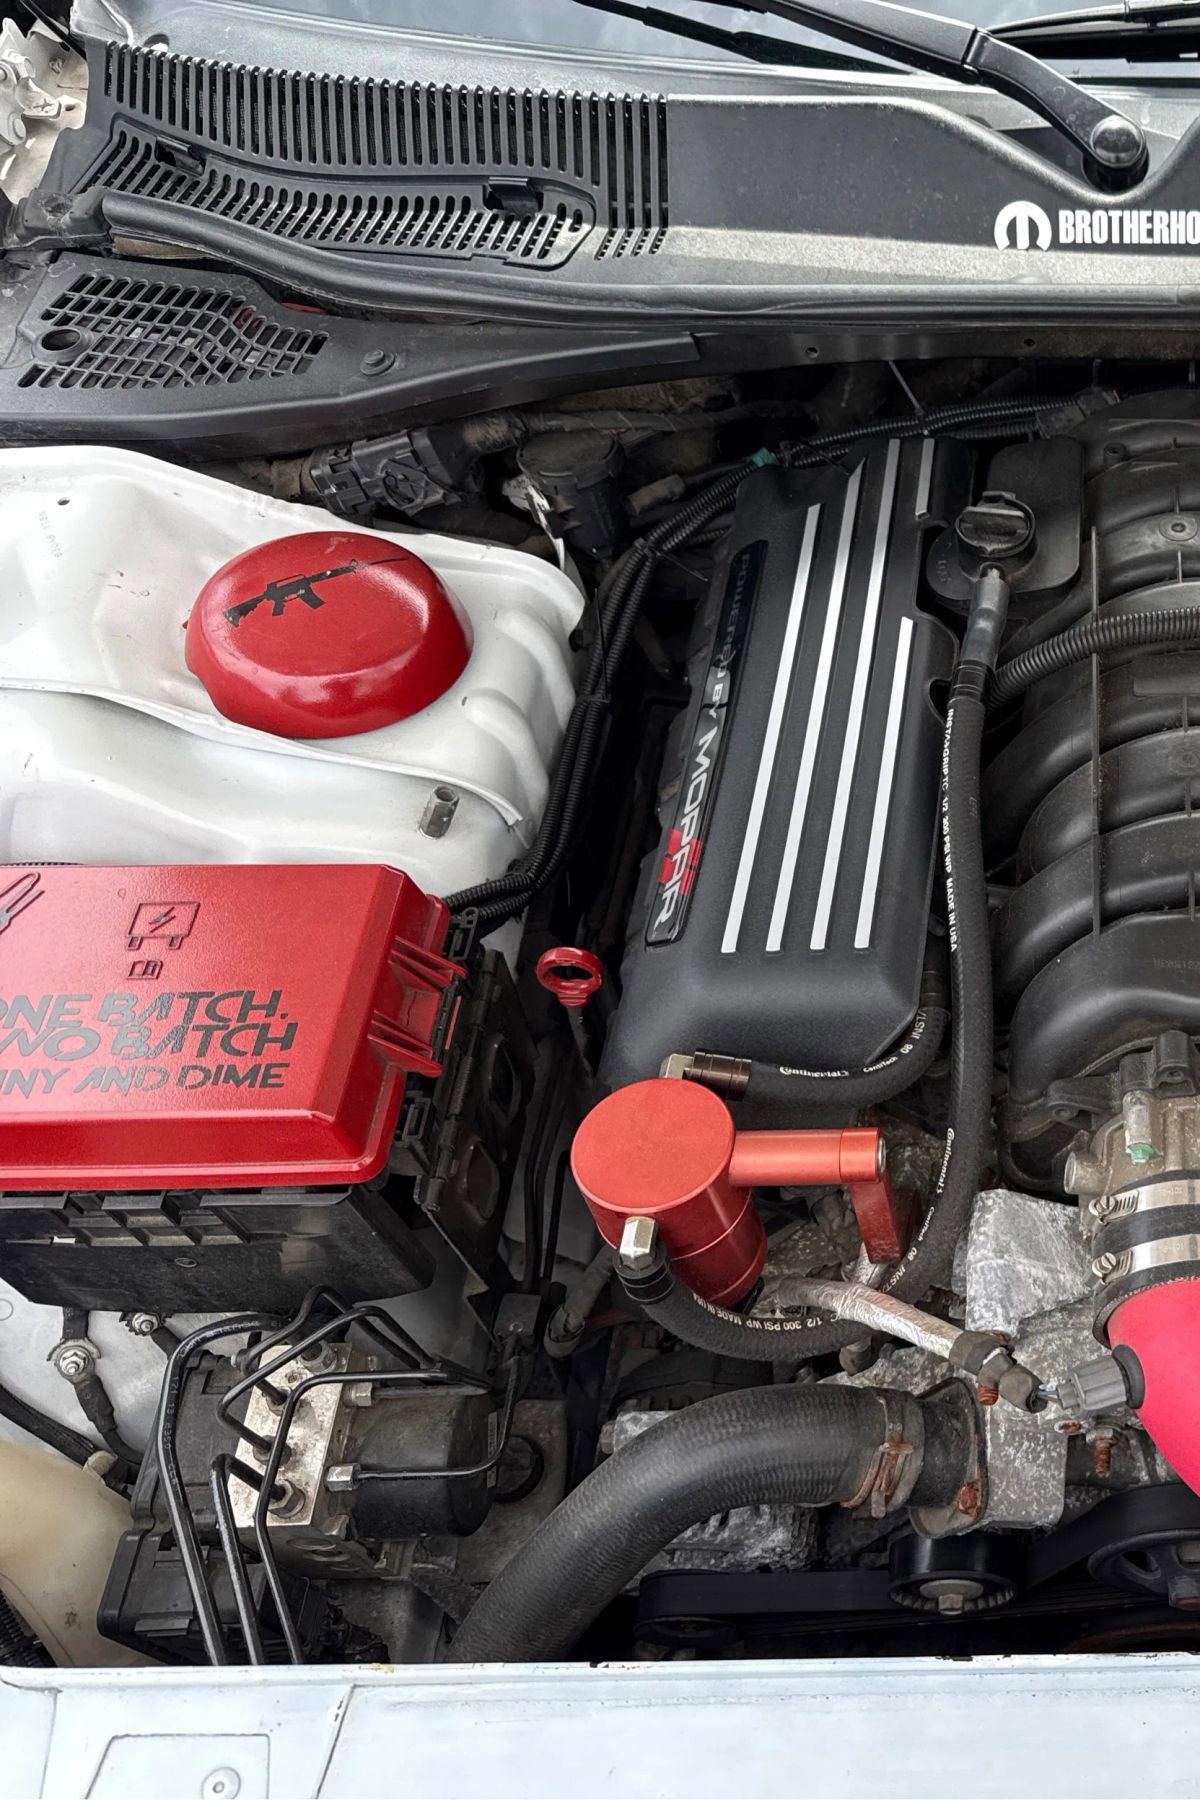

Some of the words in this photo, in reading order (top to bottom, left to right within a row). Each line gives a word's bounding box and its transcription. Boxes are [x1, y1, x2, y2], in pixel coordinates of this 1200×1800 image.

[708, 683, 724, 719] BY
[653, 725, 719, 931] MOPAR
[944, 854, 952, 873] WP
[946, 877, 955, 912] MADE
[948, 912, 956, 925] IN
[949, 926, 958, 952] USA
[0, 993, 93, 1034] NE
[0, 1026, 101, 1061] WO
[110, 1022, 299, 1060] BATCH
[73, 1064, 171, 1097] AND
[176, 1062, 291, 1090] DIME
[779, 1066, 848, 1078] Continental
[936, 1127, 955, 1191] Continental
[716, 1312, 742, 1325] MADE
[746, 1320, 763, 1329] WP
[764, 1320, 781, 1331] PSI
[783, 1320, 802, 1330] 300
[806, 1317, 823, 1328] 1/2
